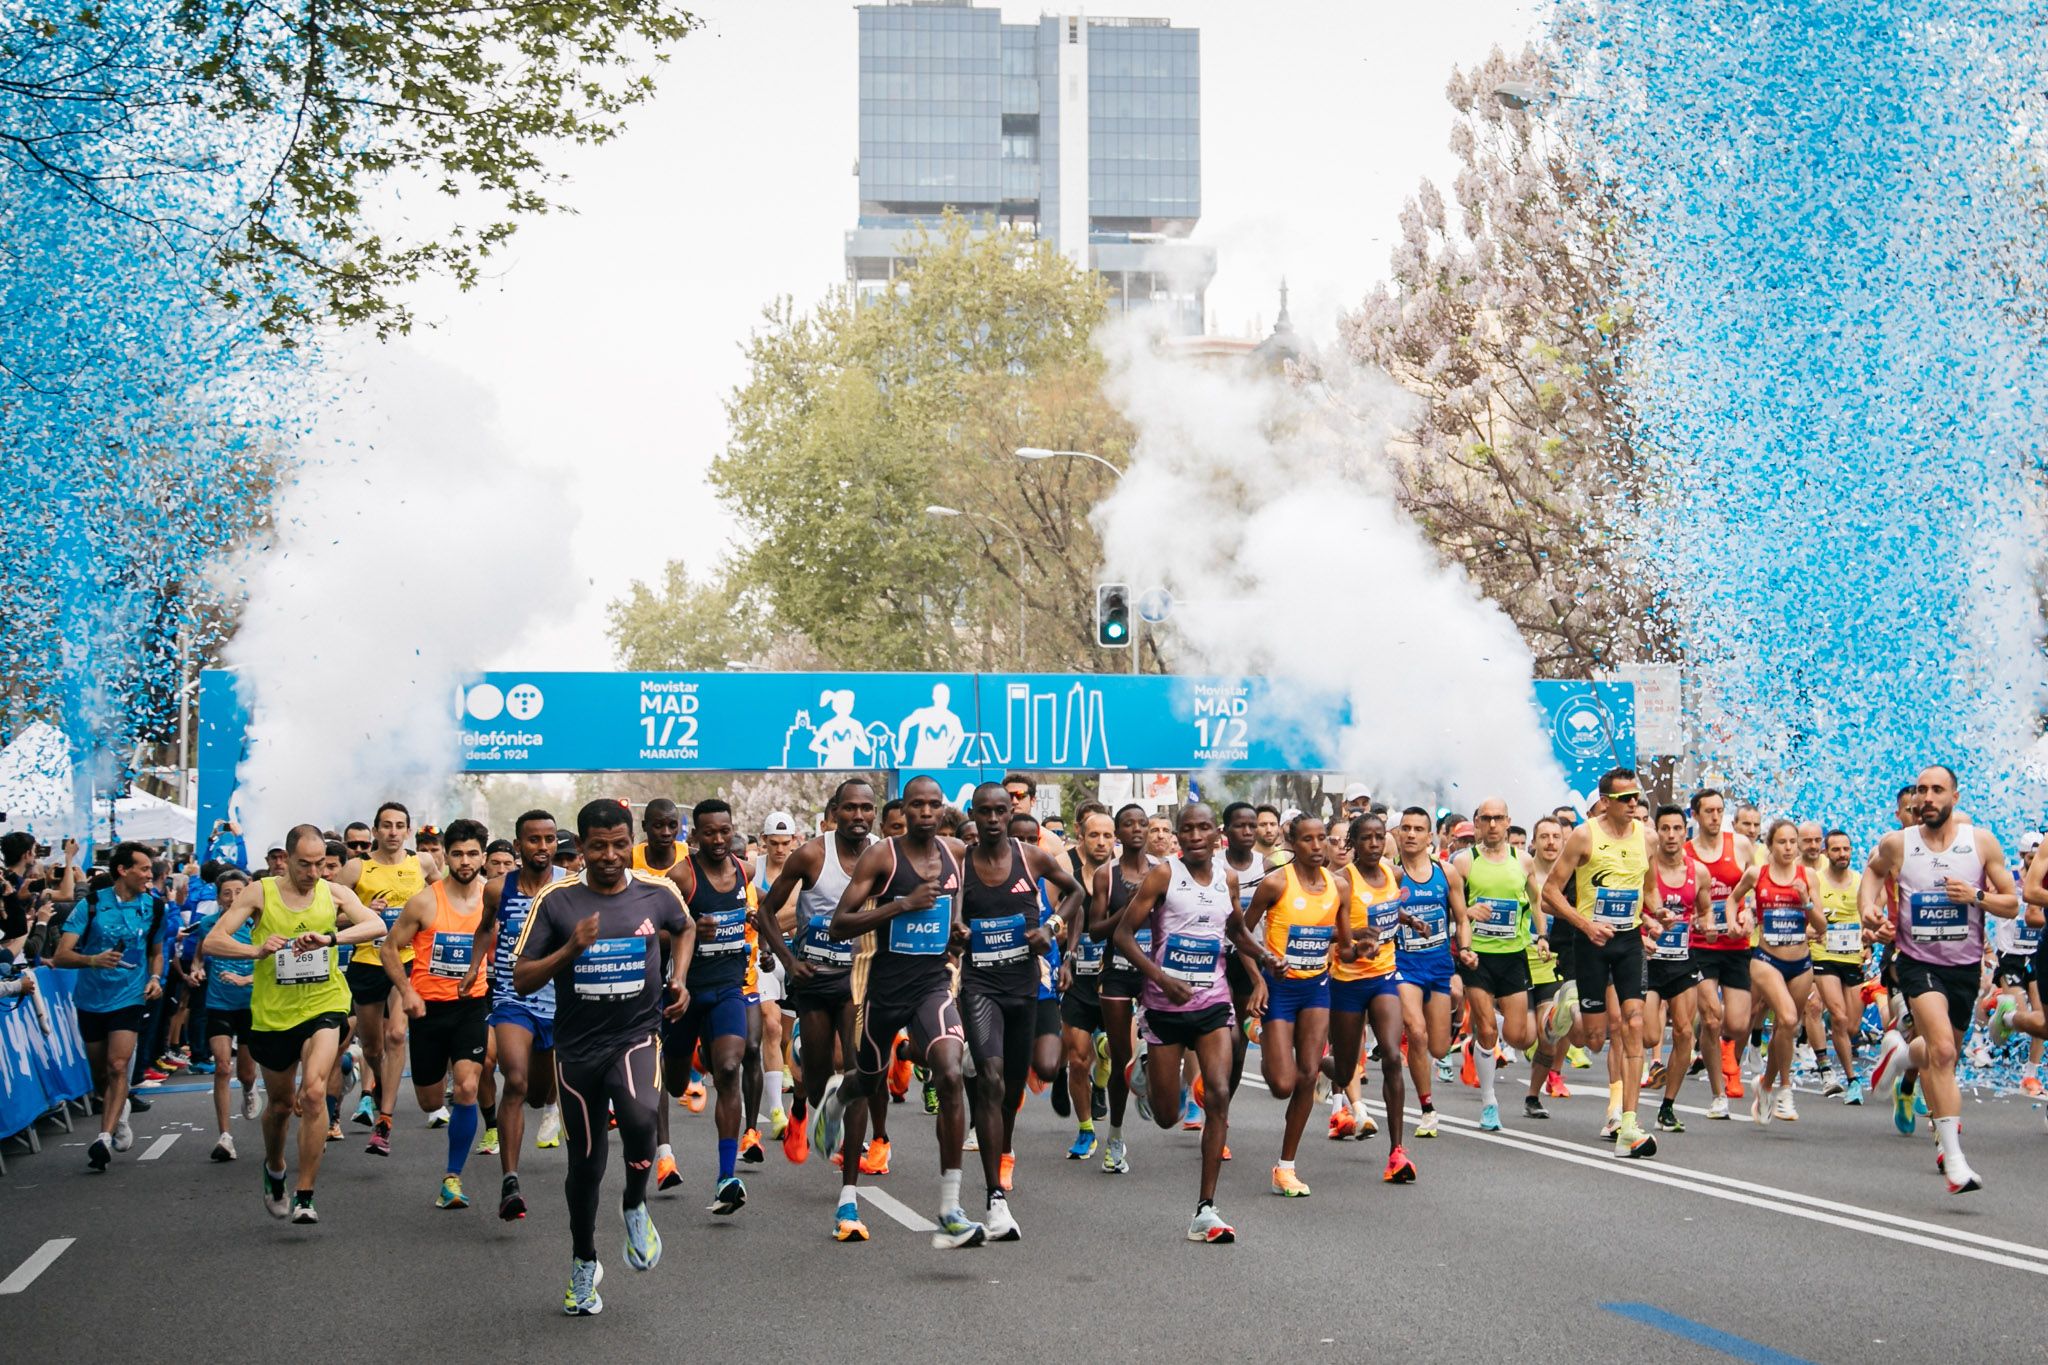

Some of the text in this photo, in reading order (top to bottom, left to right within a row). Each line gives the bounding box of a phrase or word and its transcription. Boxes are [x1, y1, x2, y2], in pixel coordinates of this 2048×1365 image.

[640, 681, 699, 693] Movistar
[1194, 685, 1248, 696] Movistar
[640, 694, 699, 715] MAD
[1194, 698, 1248, 717] MAD
[640, 716, 698, 746] 1/2
[1194, 718, 1248, 748] 1/2
[455, 730, 543, 747] Telefónica
[466, 749, 529, 760] desde 1924
[640, 747, 698, 759] MARATÓN
[1194, 749, 1248, 760] MARATÓN
[1611, 903, 1626, 912] 112
[1491, 911, 1501, 920] 73
[1920, 909, 1959, 919] PACER
[906, 922, 941, 934] PACE
[1935, 926, 1945, 935] 18
[985, 932, 1013, 945] MIKE
[295, 953, 314, 963] 269
[452, 949, 465, 958] 82
[827, 951, 838, 960] 15
[1169, 951, 1214, 965] KARIUKI
[574, 960, 646, 974] GEBRSELASSIE
[1184, 972, 1194, 981] 16
[608, 983, 613, 993] 1
